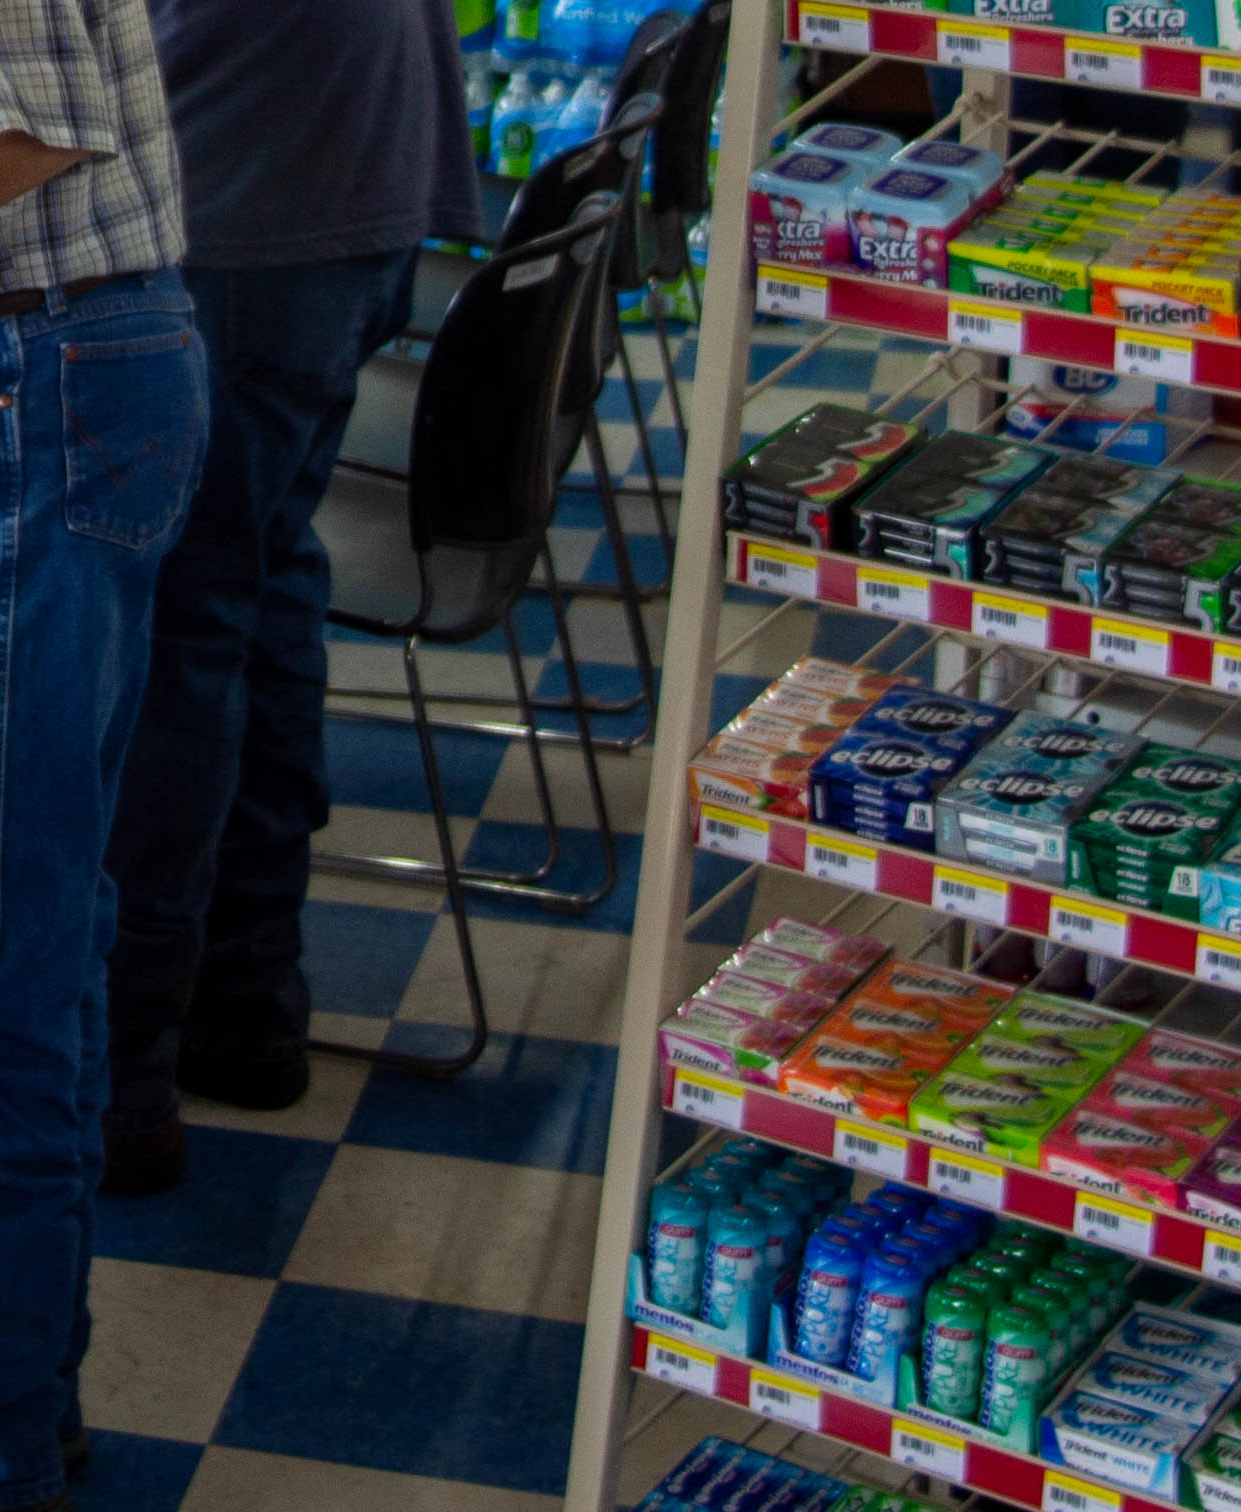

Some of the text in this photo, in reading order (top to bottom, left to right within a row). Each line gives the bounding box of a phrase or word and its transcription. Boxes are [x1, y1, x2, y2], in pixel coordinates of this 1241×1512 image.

[1107, 5, 1186, 35] Extra
[976, 279, 1063, 304] Trident
[1119, 303, 1208, 325] Trident
[874, 699, 994, 729] eclipse
[1002, 734, 1125, 755] eclipse
[829, 745, 953, 774] eclipse
[701, 782, 751, 806] Trident
[958, 775, 1084, 799] eclipse
[1088, 806, 1219, 832] eclipse
[671, 1048, 720, 1072] Trident
[633, 1303, 695, 1333] mentos
[776, 1352, 840, 1386] mentos
[1120, 1381, 1201, 1410] WHITE
[1087, 1421, 1168, 1451] WHITE
